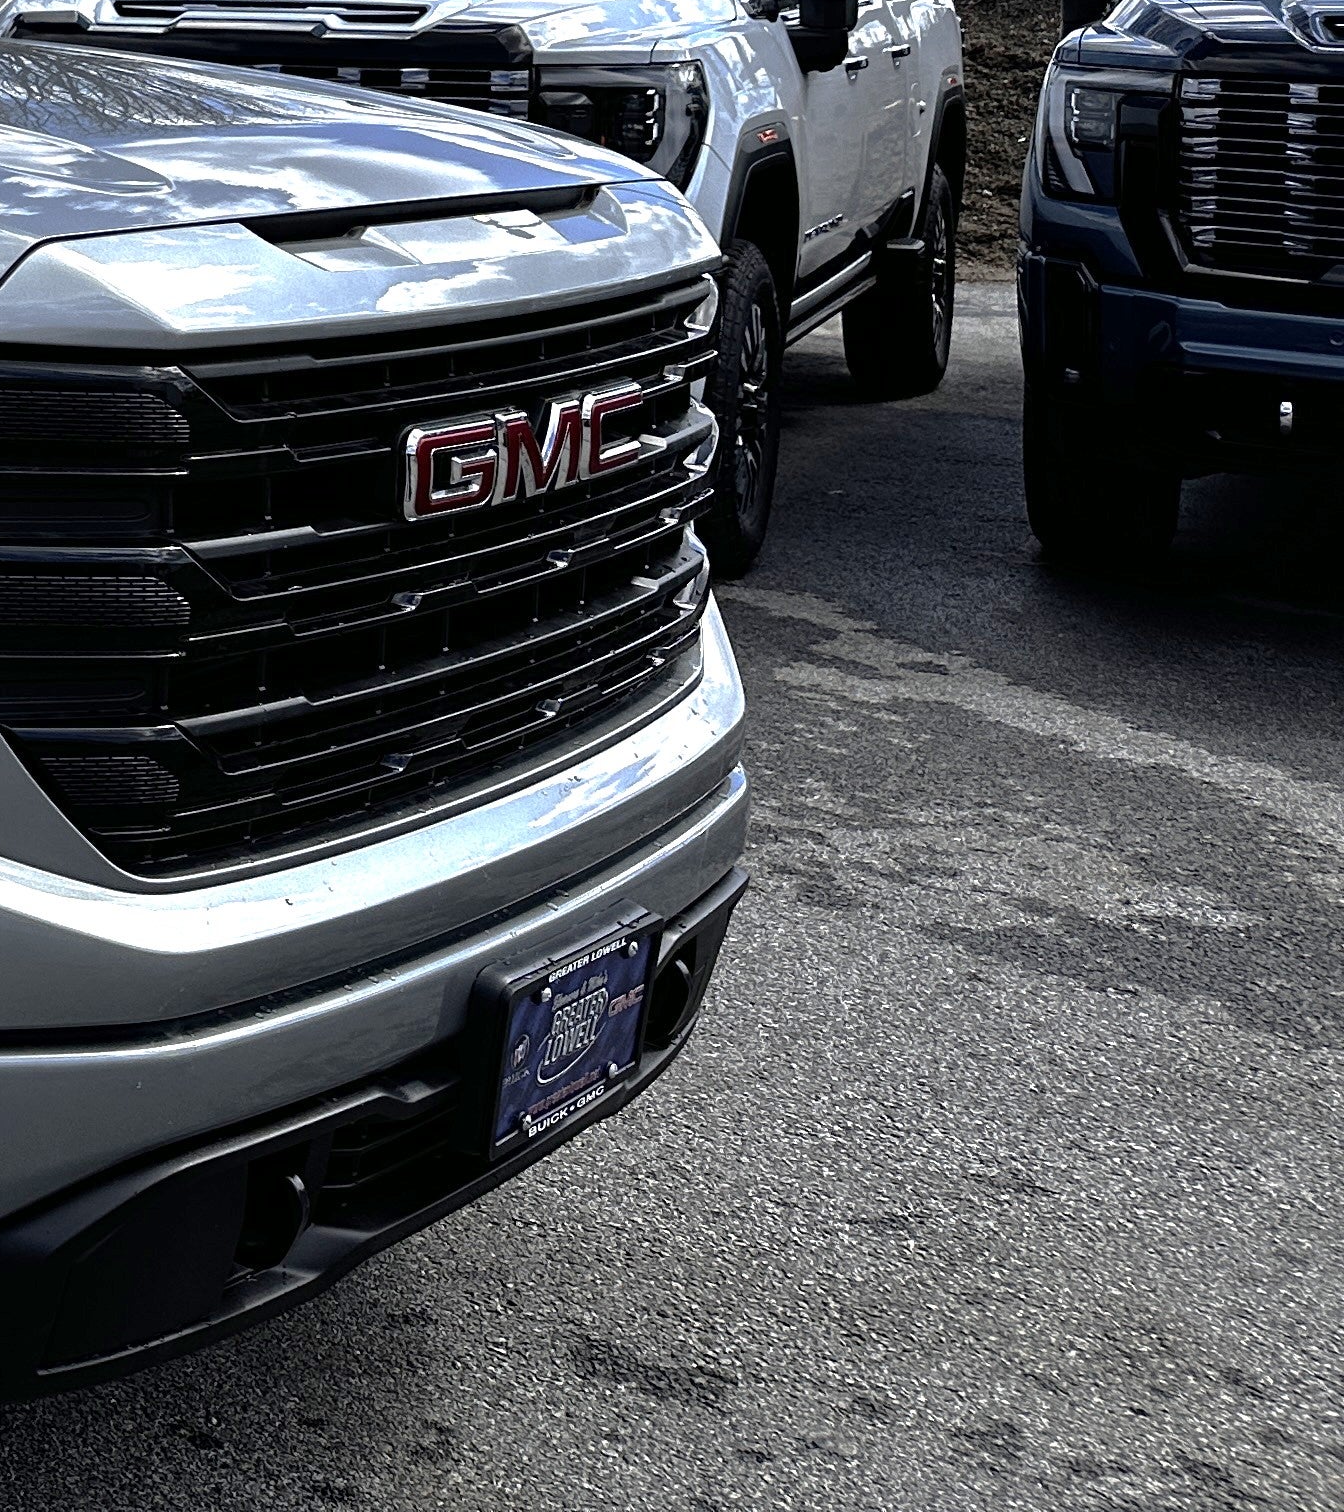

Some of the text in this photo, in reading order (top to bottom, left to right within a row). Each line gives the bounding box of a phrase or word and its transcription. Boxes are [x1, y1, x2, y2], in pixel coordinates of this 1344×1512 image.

[403, 379, 643, 522] GMC
[548, 937, 627, 983] GREATER LOWELL
[551, 990, 605, 1036] GREATER
[608, 984, 645, 1018] GMC
[543, 1014, 599, 1066] LOWELL
[528, 1106, 568, 1138] BUICK
[576, 1085, 605, 1108] GMC
